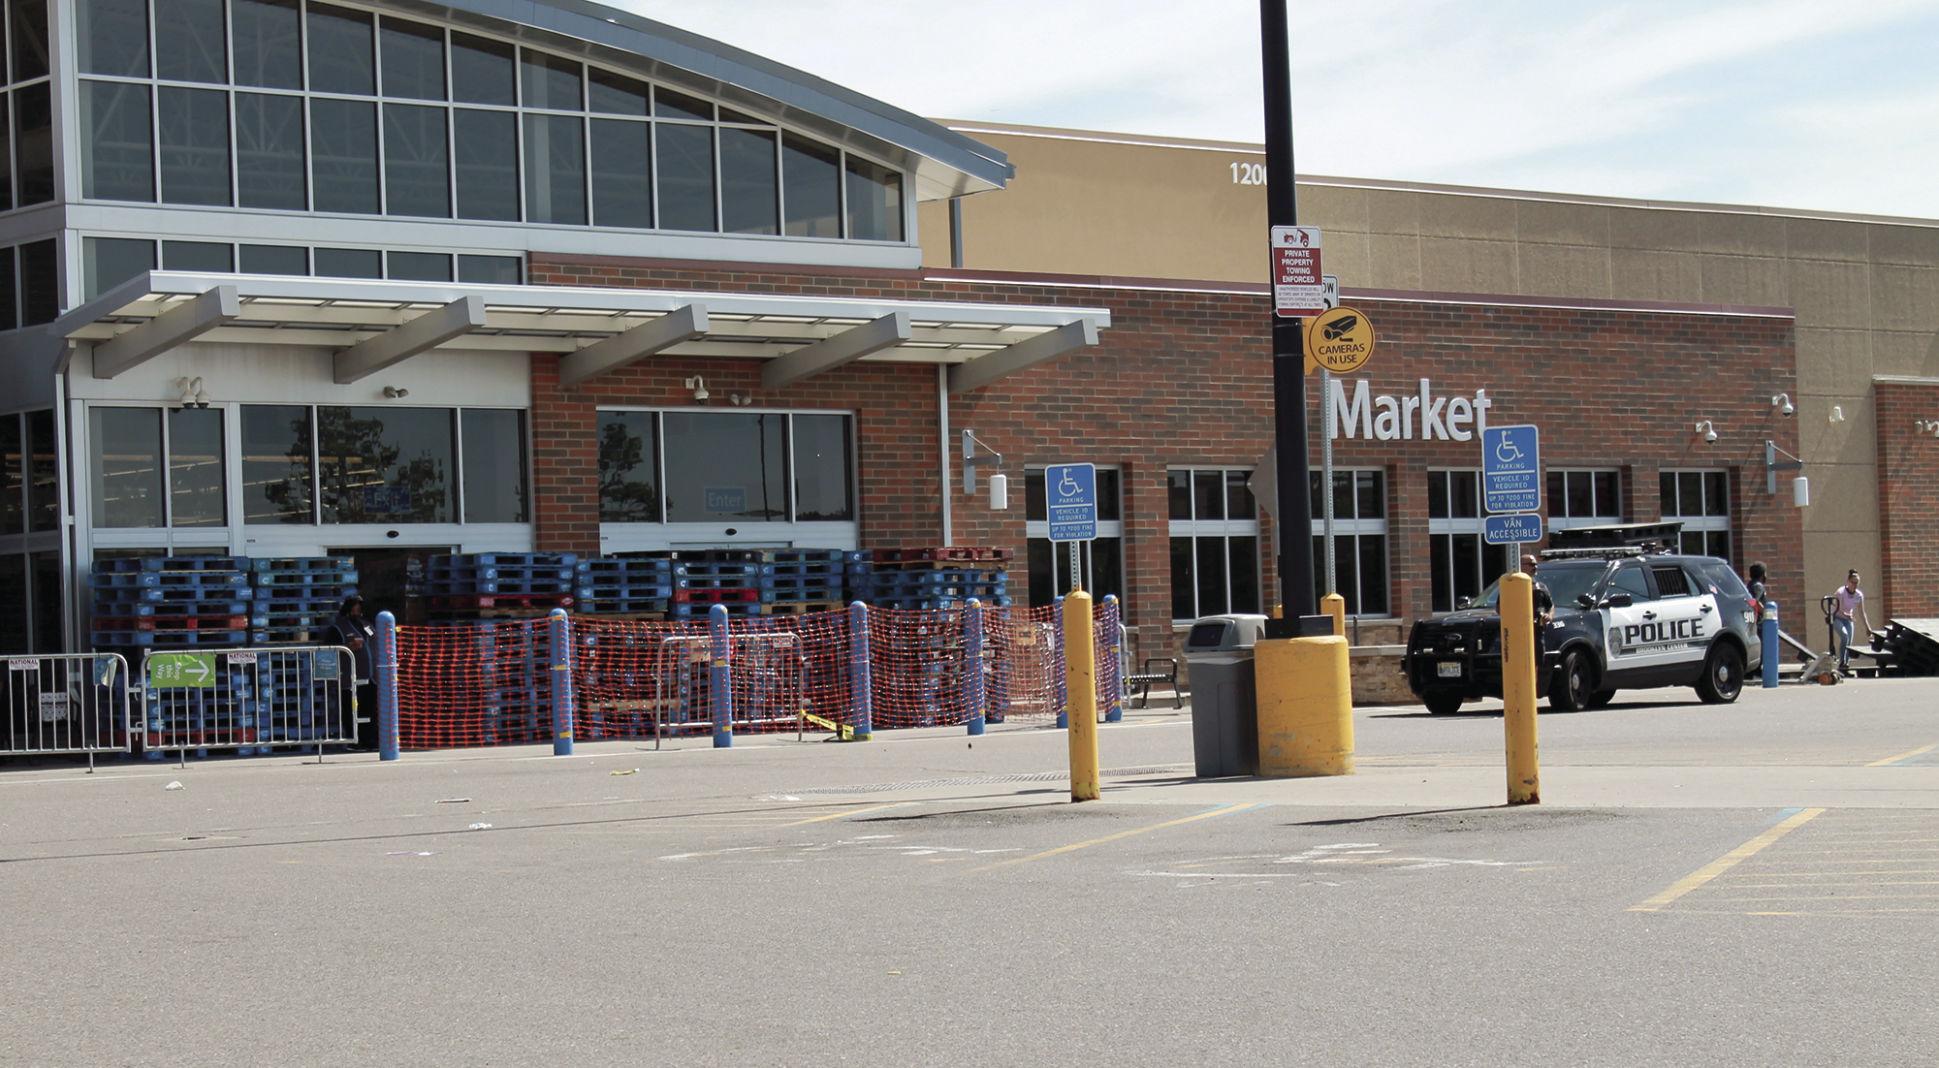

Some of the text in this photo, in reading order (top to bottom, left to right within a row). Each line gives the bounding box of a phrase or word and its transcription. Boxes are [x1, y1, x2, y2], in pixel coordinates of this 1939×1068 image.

[1230, 162, 1267, 186] 120
[1281, 258, 1314, 266] PROPERTY
[1282, 275, 1315, 283] ENFORCED
[1318, 343, 1365, 355] CAMERAS
[1327, 354, 1357, 364] IN USE
[1330, 378, 1491, 441] Market
[708, 492, 741, 508] Enter
[1504, 519, 1522, 528] VAN
[1489, 528, 1538, 540] ACCESSIBLE
[1624, 618, 1705, 644] POLICE
[156, 663, 164, 680] Way
